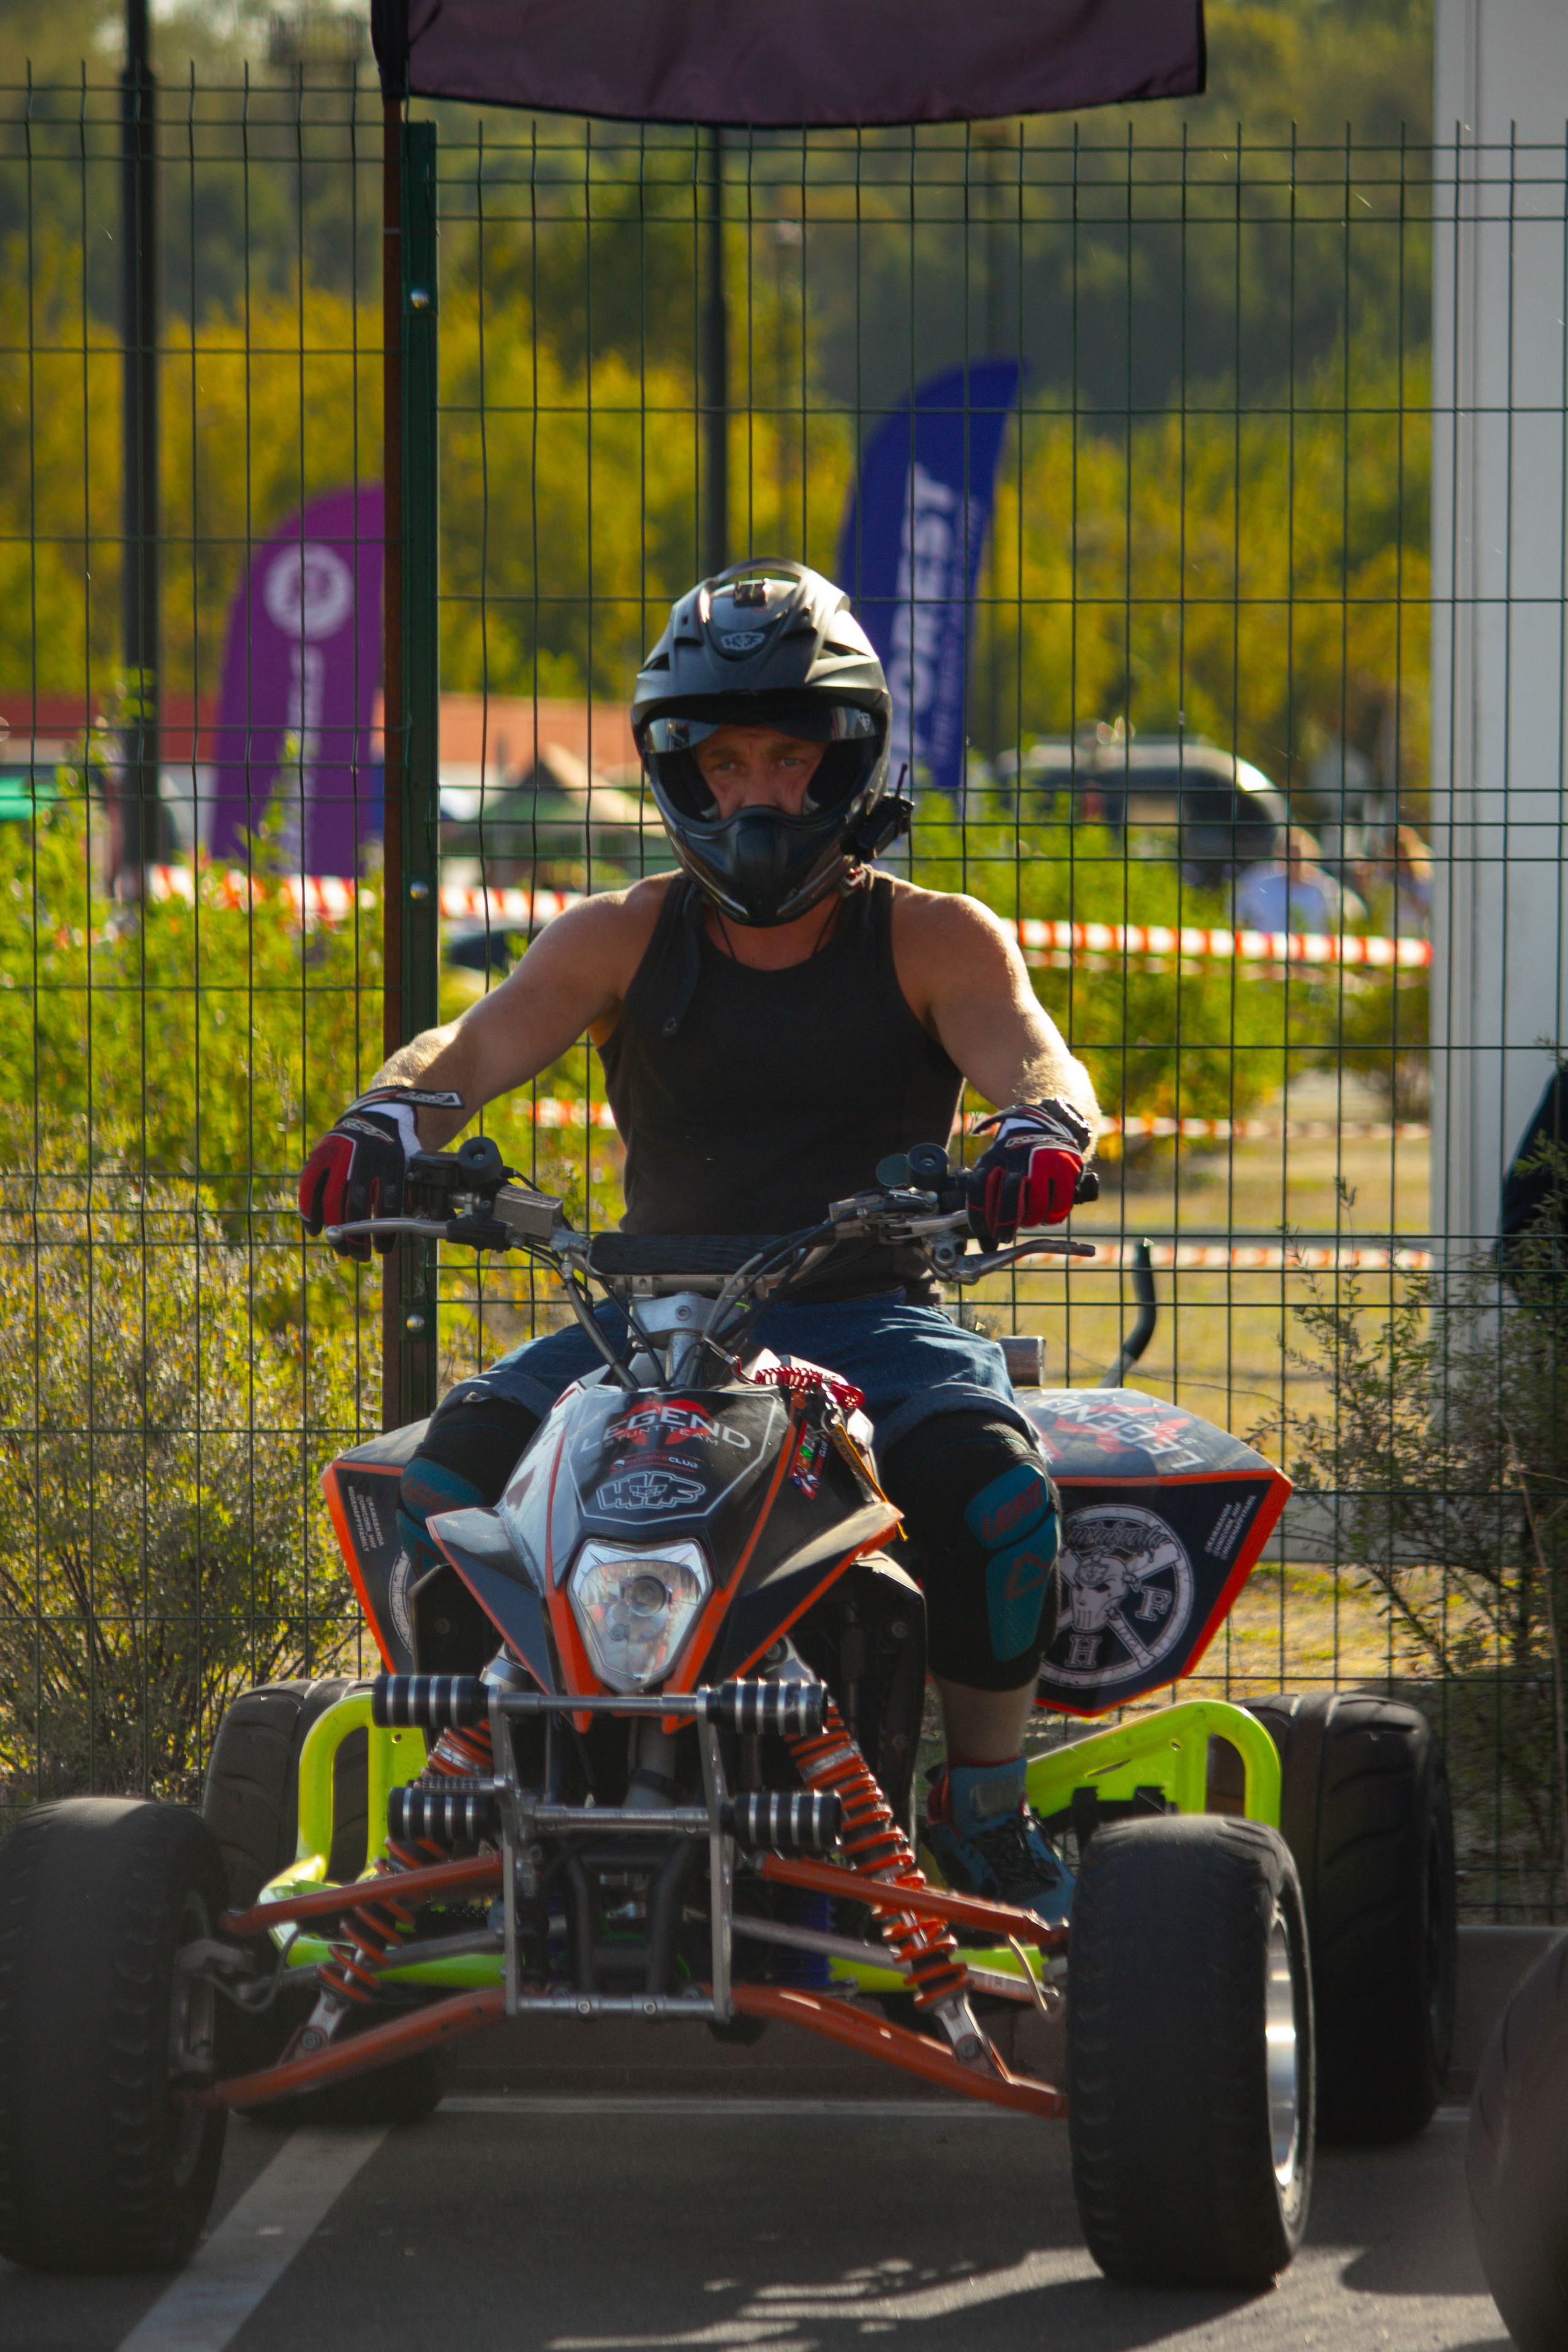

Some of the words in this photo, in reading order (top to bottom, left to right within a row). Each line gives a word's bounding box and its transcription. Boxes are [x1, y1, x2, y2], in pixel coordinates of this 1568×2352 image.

[579, 1406, 752, 1453] LEGEND
[1039, 1399, 1205, 1469] LEGEND
[356, 1494, 376, 1550] @UNICORN_HHF
[365, 1496, 385, 1547] @KAWABANDA
[1064, 1634, 1104, 1668] H
